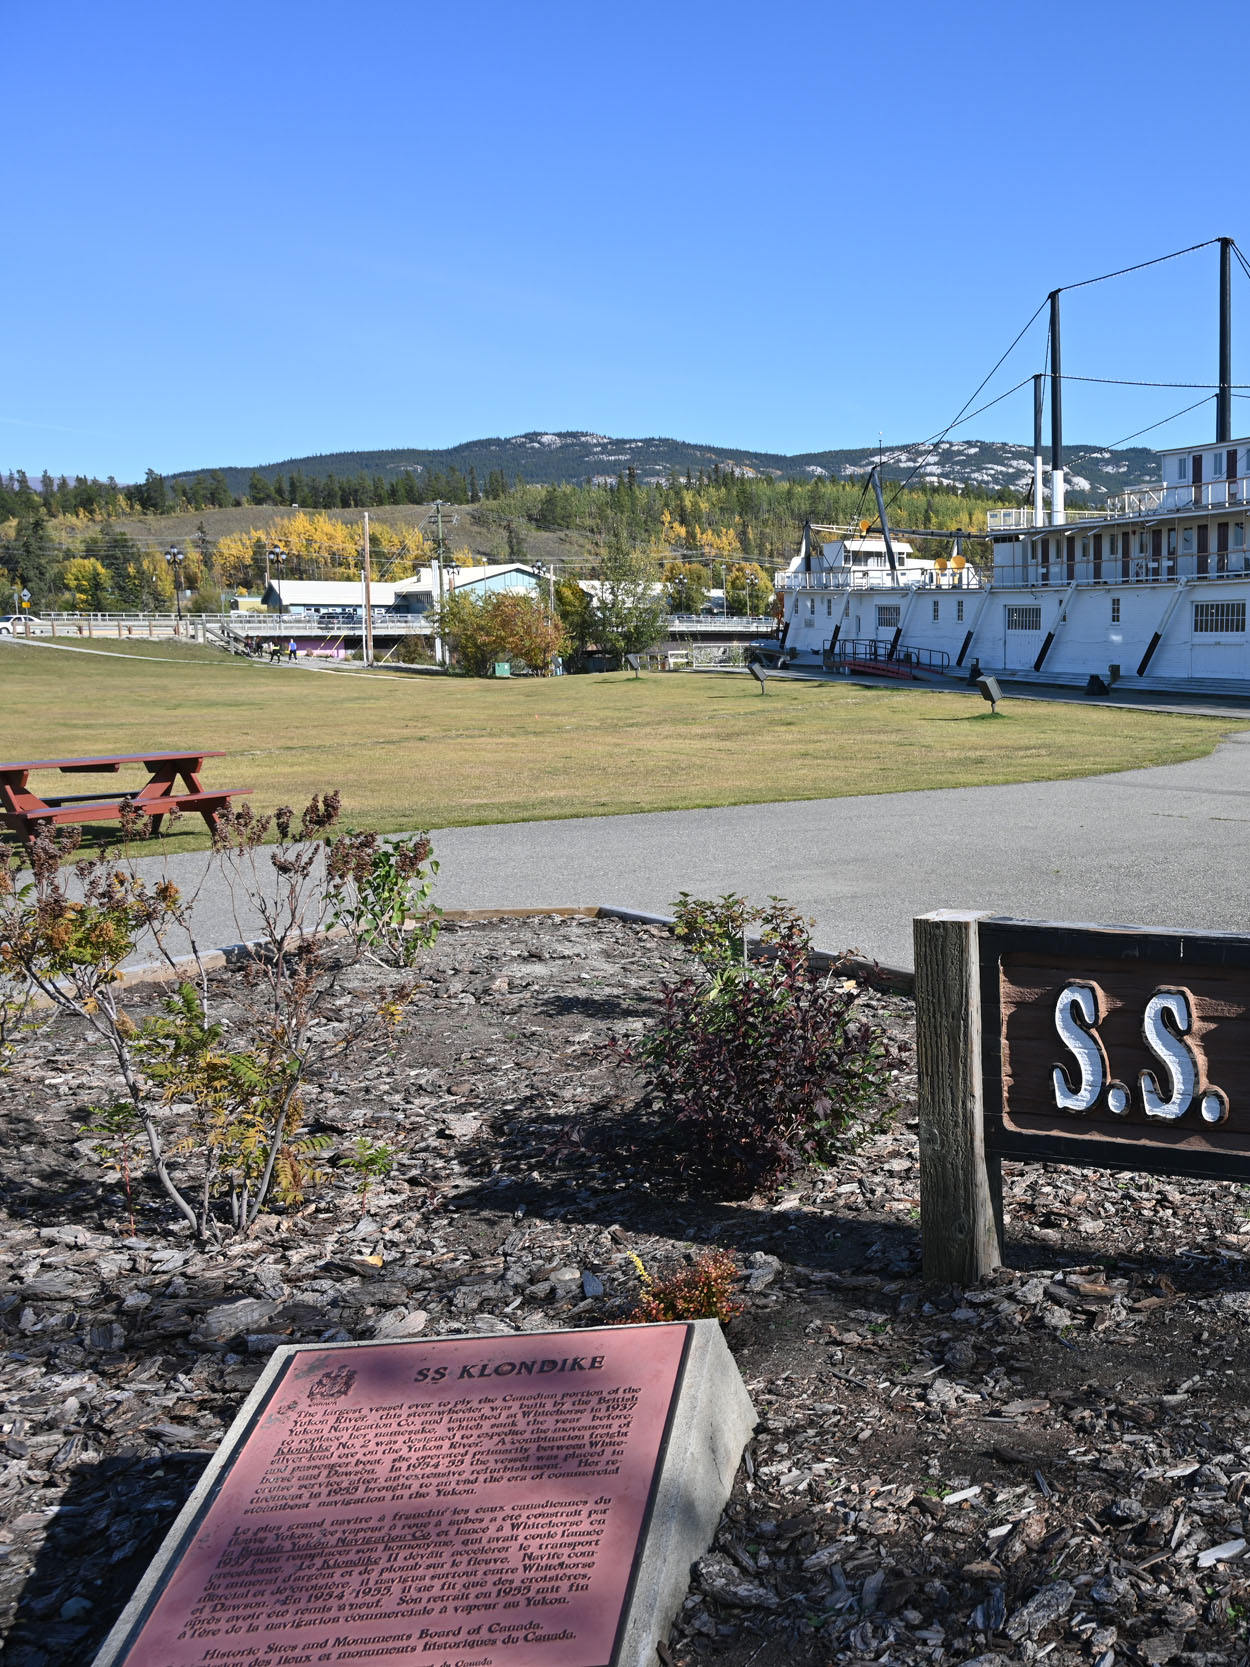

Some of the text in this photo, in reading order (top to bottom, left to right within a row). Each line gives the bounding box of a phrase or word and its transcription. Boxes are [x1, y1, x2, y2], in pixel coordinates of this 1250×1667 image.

[1052, 985, 1222, 1123] S.S.
[414, 1354, 607, 1384] SS KLONDIKE
[291, 1417, 329, 1426] Yukon
[378, 1412, 403, 1420] this
[405, 1405, 484, 1418] sternwheeler
[519, 1400, 547, 1409] built
[552, 1399, 566, 1408] by
[571, 1397, 591, 1405] the
[597, 1393, 639, 1403] British
[295, 1409, 318, 1418] The
[321, 1406, 364, 1417] largest
[368, 1402, 404, 1412] vessel
[453, 1398, 473, 1408] ply
[477, 1396, 497, 1404] the
[501, 1392, 557, 1402] Canadian
[560, 1389, 603, 1400] portion
[607, 1386, 621, 1394] of
[622, 1385, 641, 1393] the
[286, 1426, 324, 1435] Yukon
[328, 1422, 392, 1432] Navigation
[395, 1419, 415, 1427] Co.
[420, 1416, 443, 1425] and
[447, 1412, 502, 1423] launched
[520, 1407, 586, 1418] Whitehorse
[604, 1402, 636, 1411] 1937
[298, 1434, 343, 1445] replace
[347, 1431, 369, 1439] her
[373, 1426, 437, 1437] namesake,
[446, 1422, 484, 1432] which
[489, 1419, 519, 1429] sank
[526, 1418, 546, 1426] the
[553, 1417, 582, 1426] year
[275, 1442, 333, 1454] Klondike
[336, 1441, 356, 1449] No.
[360, 1439, 372, 1447] 2
[402, 1432, 456, 1444] designed
[476, 1428, 526, 1439] expedite
[530, 1426, 551, 1434] the
[553, 1422, 612, 1432] movement
[618, 1419, 632, 1428] of
[381, 1446, 402, 1455] the
[404, 1443, 443, 1453] Yukon
[494, 1437, 507, 1446] A
[510, 1433, 585, 1445] combination
[588, 1429, 628, 1440] freight
[289, 1461, 351, 1474] passenger
[354, 1457, 384, 1466] boat,
[391, 1454, 412, 1463] she
[414, 1449, 468, 1463] operated
[471, 1445, 530, 1459] primarily
[535, 1443, 586, 1451] between
[296, 1470, 322, 1480] and
[388, 1464, 402, 1472] In
[469, 1457, 489, 1466] the
[493, 1453, 530, 1464] vessel
[563, 1448, 605, 1461] placed
[254, 1484, 294, 1493] cruise
[296, 1480, 344, 1490] service
[404, 1469, 465, 1480] extensive
[577, 1458, 600, 1467] Her
[325, 1486, 359, 1496] 1955
[363, 1482, 412, 1494] brought
[418, 1481, 432, 1489] to
[483, 1474, 503, 1484] the
[530, 1471, 546, 1480] of
[547, 1465, 620, 1478] commercial
[316, 1495, 386, 1507] navigation
[389, 1493, 403, 1501] in
[407, 1490, 429, 1500] the
[508, 1519, 583, 1531] Whitehorse
[318, 1555, 382, 1568] Klondike
[202, 1645, 261, 1659] Historic
[263, 1642, 299, 1653] Sites
[301, 1637, 330, 1650] and
[331, 1632, 412, 1647] Monuments
[416, 1626, 462, 1640] Board
[466, 1624, 484, 1635] of
[336, 1643, 417, 1658] monuments
[421, 1637, 502, 1651] historiques
[500, 1633, 519, 1644] du
